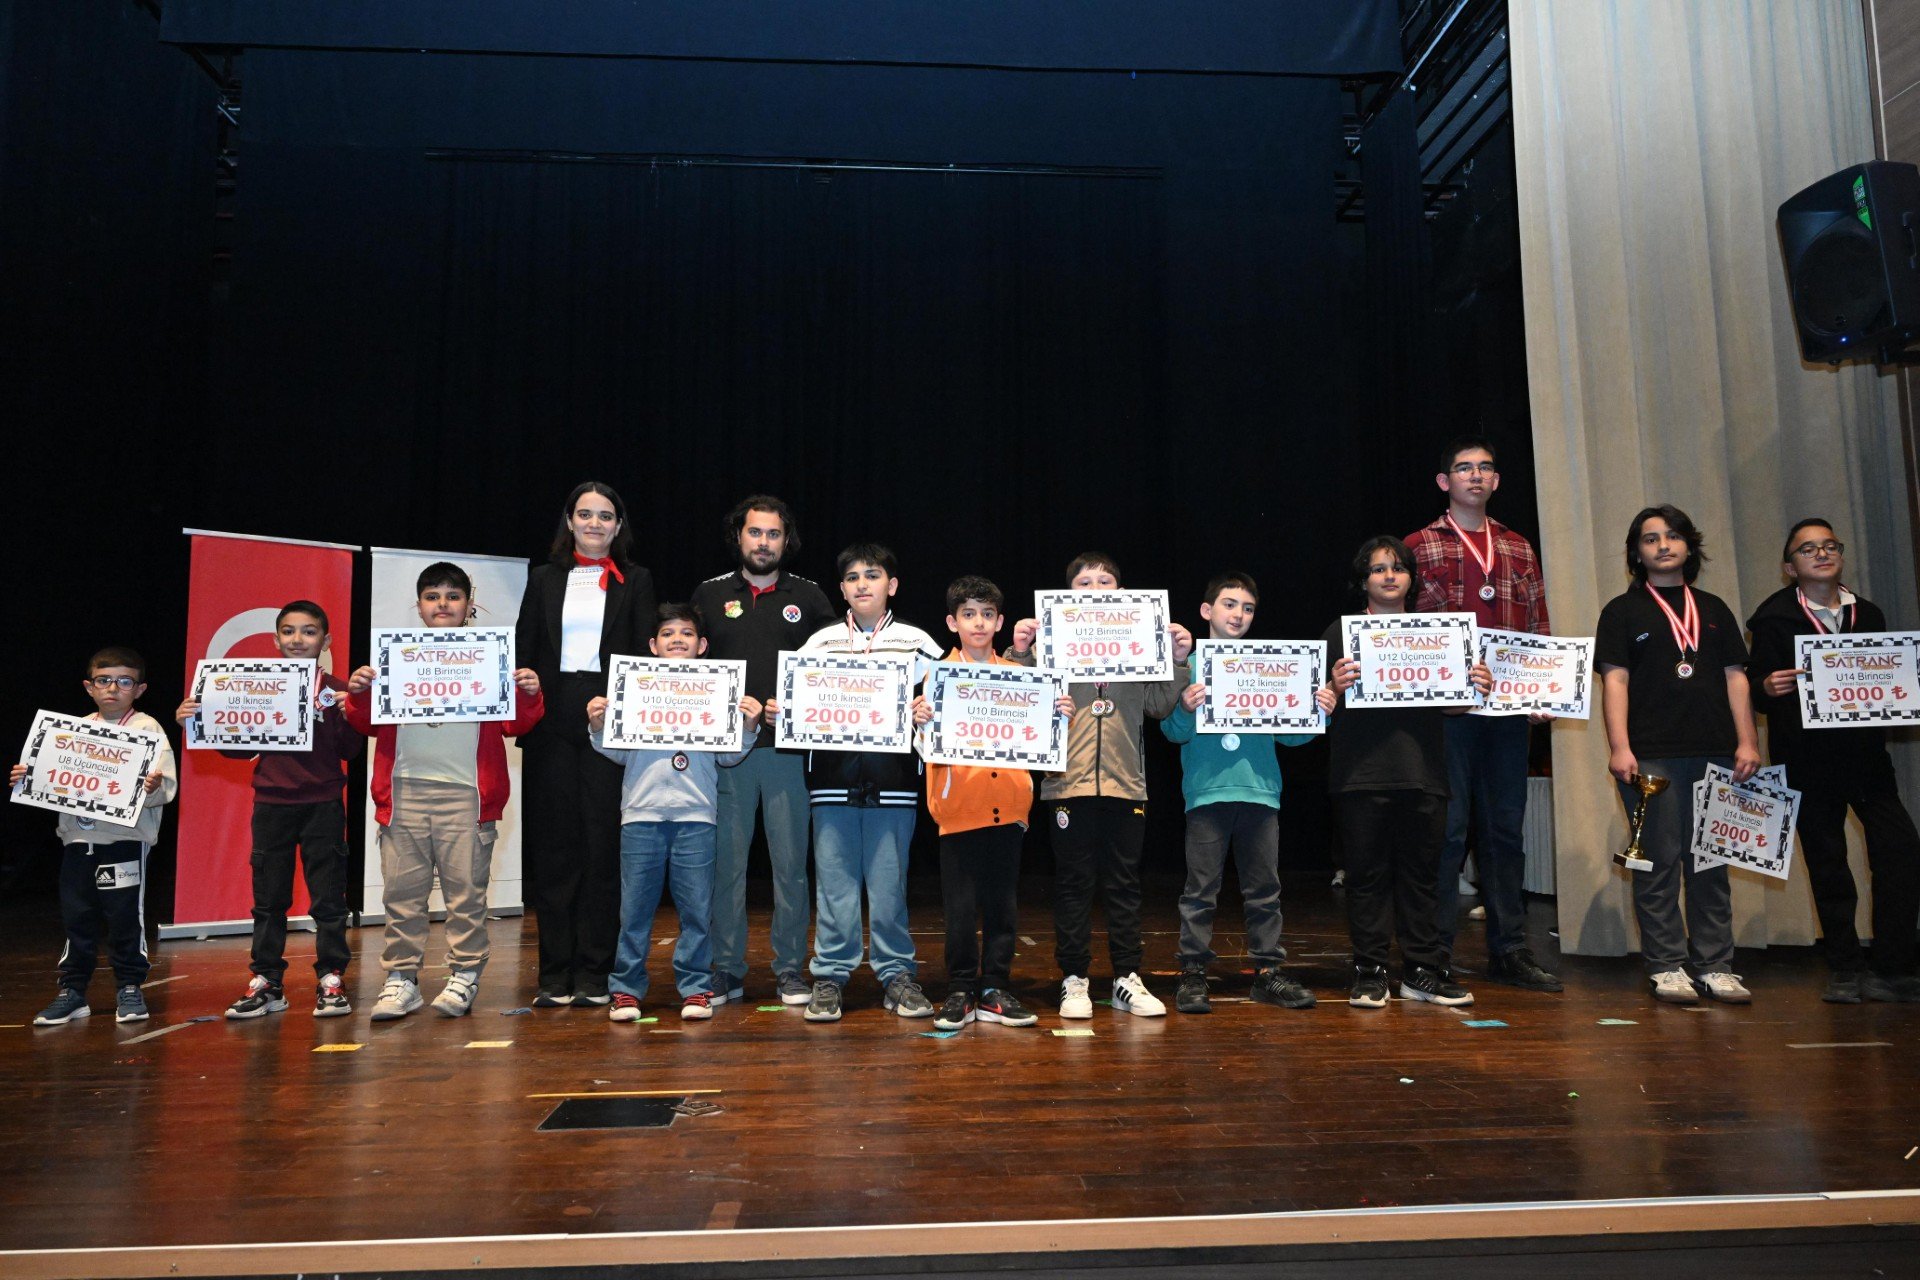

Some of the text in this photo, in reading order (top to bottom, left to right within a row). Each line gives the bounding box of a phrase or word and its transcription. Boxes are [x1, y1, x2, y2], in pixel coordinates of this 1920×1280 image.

[1065, 611, 1140, 624] SATRANÇ
[1374, 635, 1450, 648] SATRANÇ
[404, 650, 485, 662] SATRANÇ
[1066, 642, 1121, 657] 3000
[1401, 652, 1446, 662] Üçüncüsü
[1496, 651, 1564, 668] SATRANÇ
[1825, 655, 1902, 668] SATRANÇ
[435, 667, 471, 675] Birincisi
[1226, 663, 1298, 675] SATRANÇ
[1376, 667, 1429, 681] 1000
[1509, 668, 1552, 677] Üçüncüsü
[807, 676, 884, 691] SATRANÇ
[1836, 672, 1894, 681] U14 Birincisi
[215, 680, 287, 694] SATRANÇ
[403, 682, 462, 697] 3000
[639, 680, 716, 694] SATRANÇ
[1491, 680, 1539, 694] 1000
[243, 696, 272, 704] İkincisi
[665, 697, 710, 706] Üçüncüsü
[841, 693, 871, 703] İkincisi
[958, 688, 1040, 706] SATRANÇ
[1225, 694, 1277, 707] 2000
[1828, 687, 1883, 702] 3000
[215, 711, 265, 724] 2000
[637, 710, 691, 724] 1000
[805, 708, 860, 724] 2000
[968, 707, 1027, 717] U10 Birincisi
[955, 722, 1014, 739] 3000
[55, 737, 131, 764] SATRANÇ
[58, 755, 71, 765] U8
[74, 757, 119, 774] Üçüncüsü
[47, 769, 99, 791] 1000
[1718, 791, 1774, 818] SATRANÇ
[1724, 809, 1737, 818] U14
[1710, 820, 1749, 843] 2000
